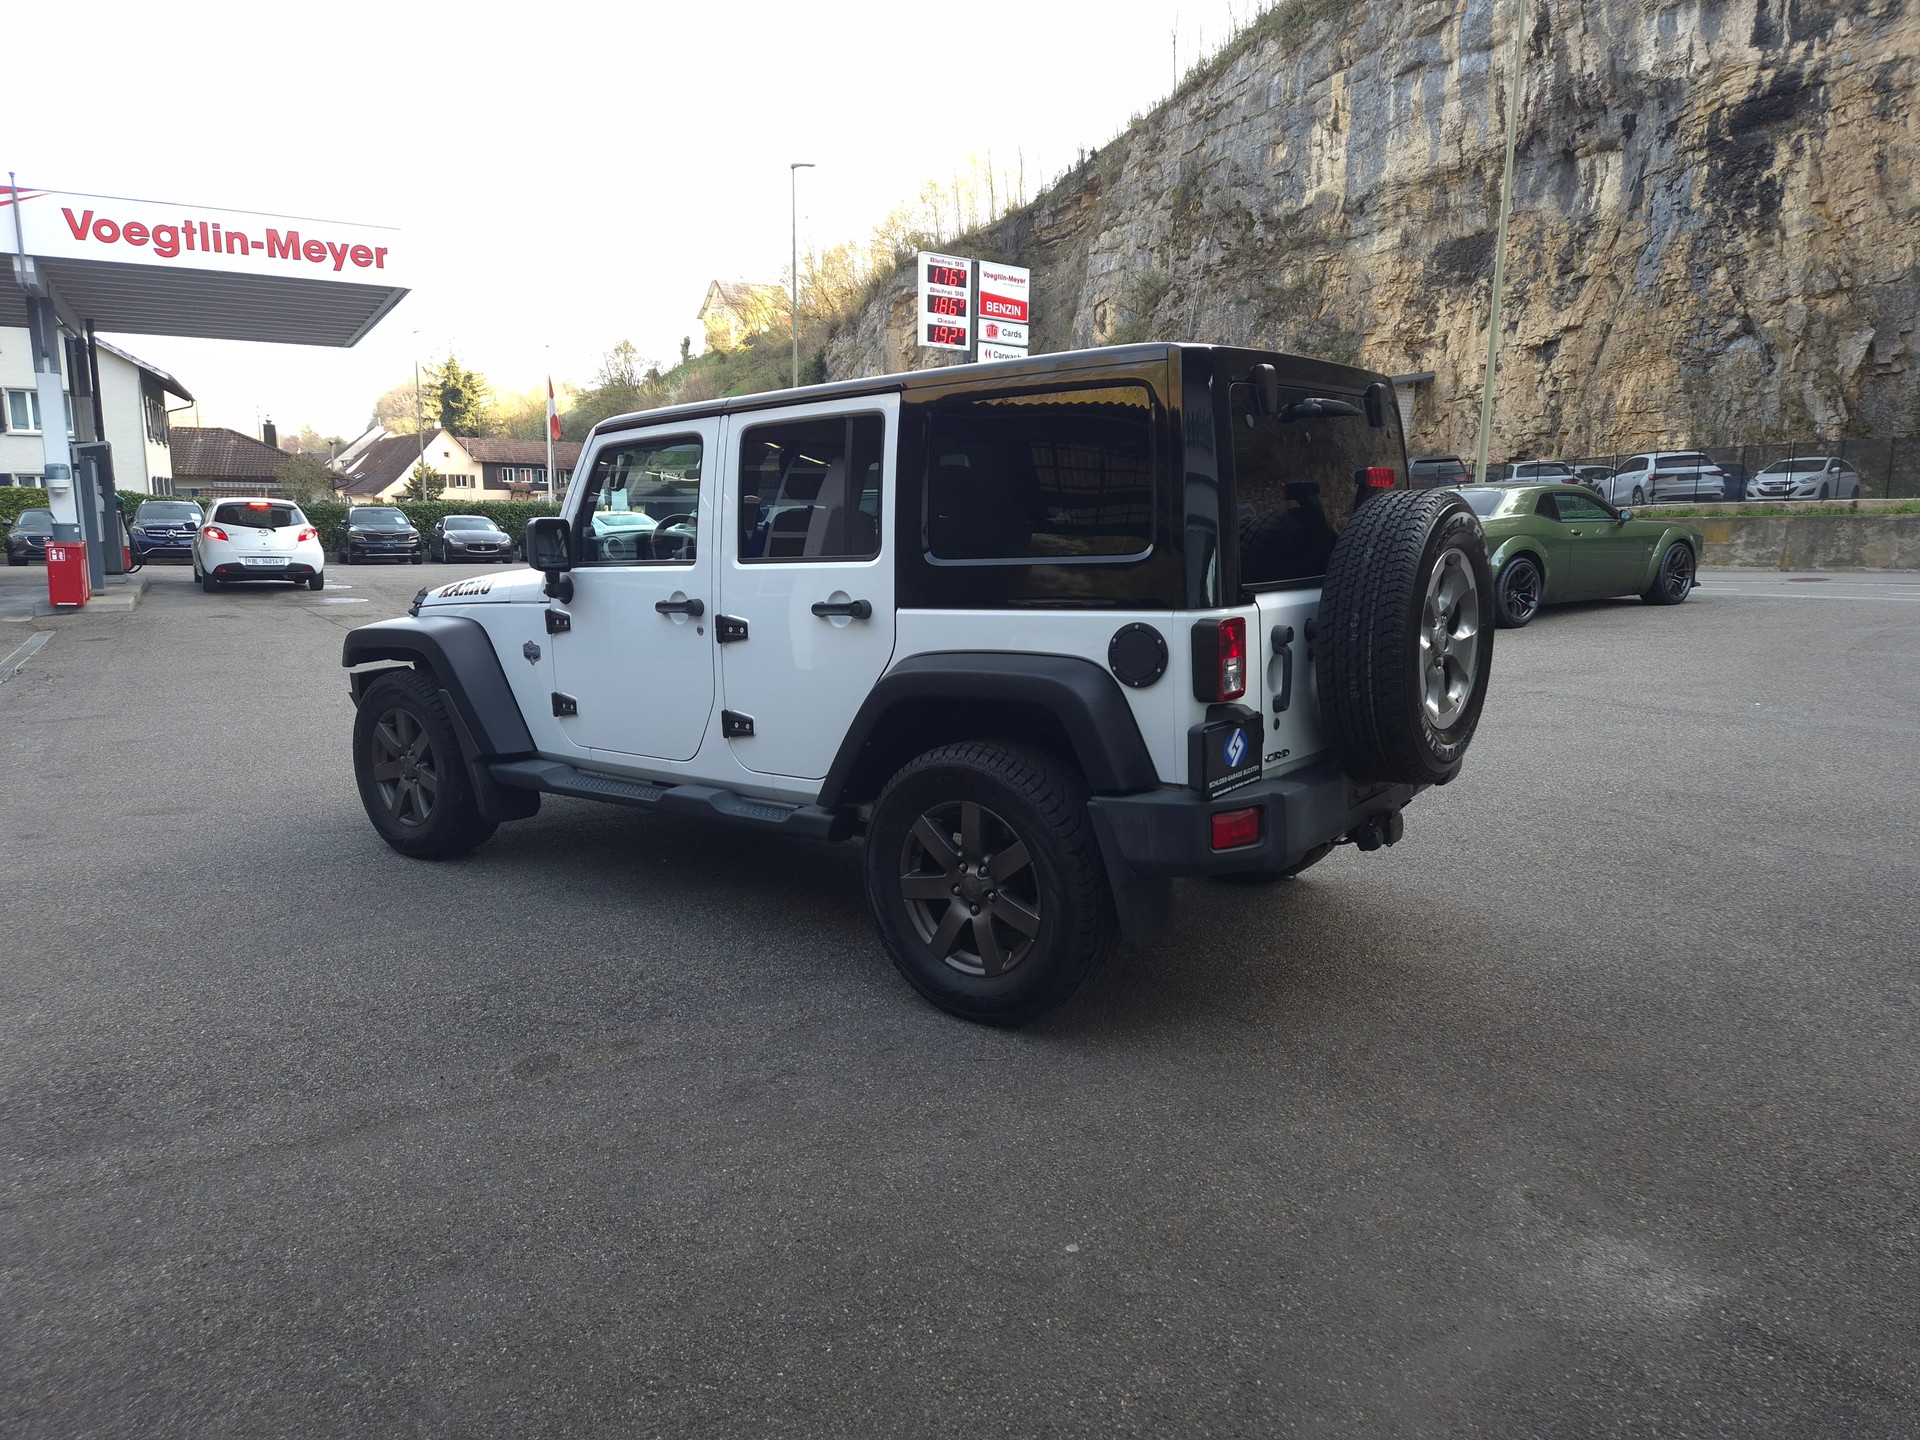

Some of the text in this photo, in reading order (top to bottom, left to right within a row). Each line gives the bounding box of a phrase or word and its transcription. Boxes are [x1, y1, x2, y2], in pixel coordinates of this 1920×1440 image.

[61, 207, 388, 271] Voegtlin-Meyer
[930, 257, 953, 266] Bleifrei
[983, 270, 1026, 284] Voegtlin-Meyer
[930, 287, 953, 296] Bleifrei
[986, 301, 1021, 316] BENZIN
[937, 317, 957, 325] Diesel
[1002, 328, 1022, 339] Cards
[1264, 749, 1290, 762] CRD
